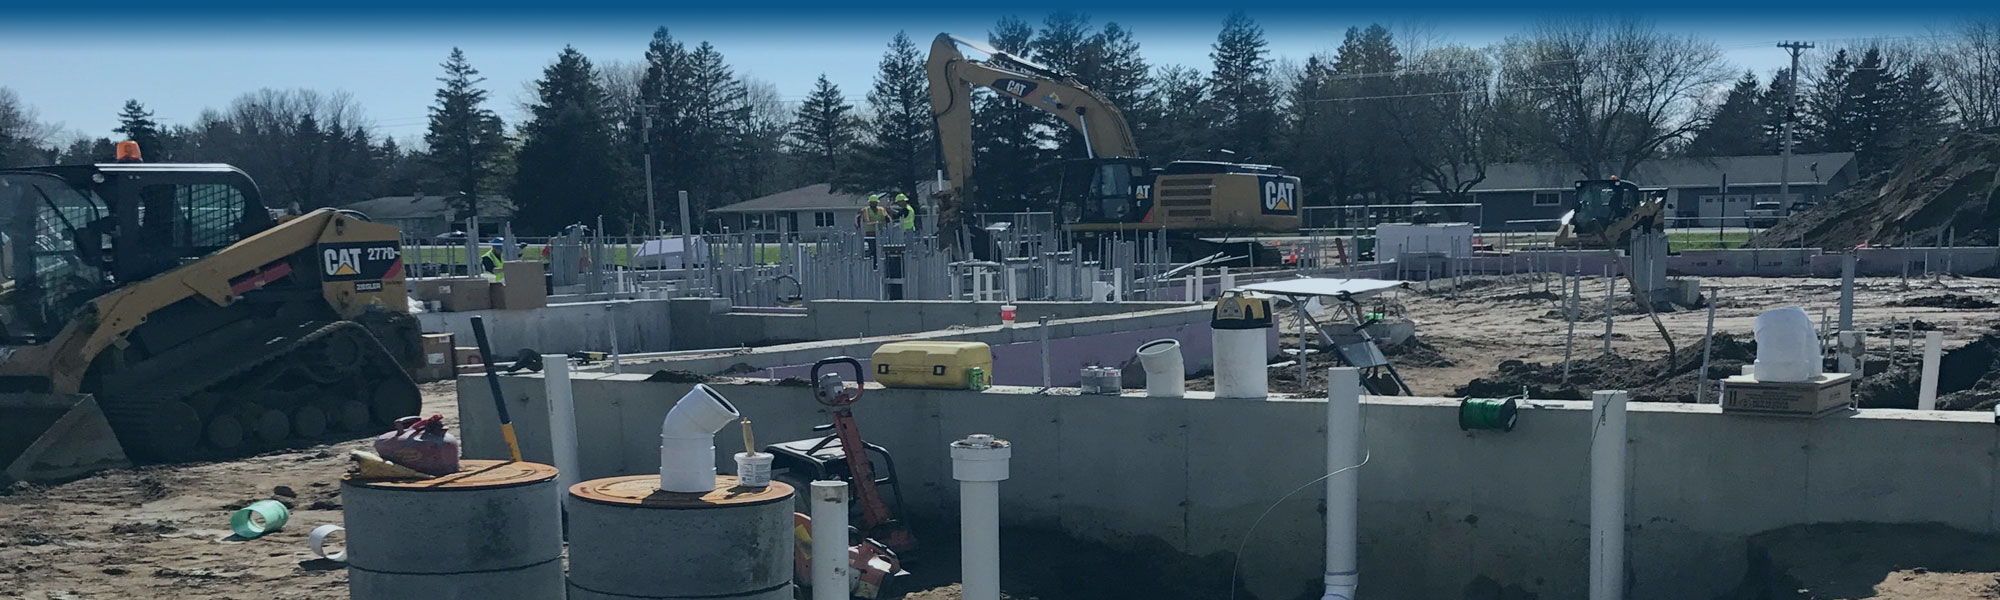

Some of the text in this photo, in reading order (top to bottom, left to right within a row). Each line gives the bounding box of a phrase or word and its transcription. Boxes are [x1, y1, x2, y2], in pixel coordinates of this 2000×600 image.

[1006, 79, 1027, 97] CAT
[1265, 181, 1294, 211] CAT
[324, 246, 395, 276] CAT 277D
